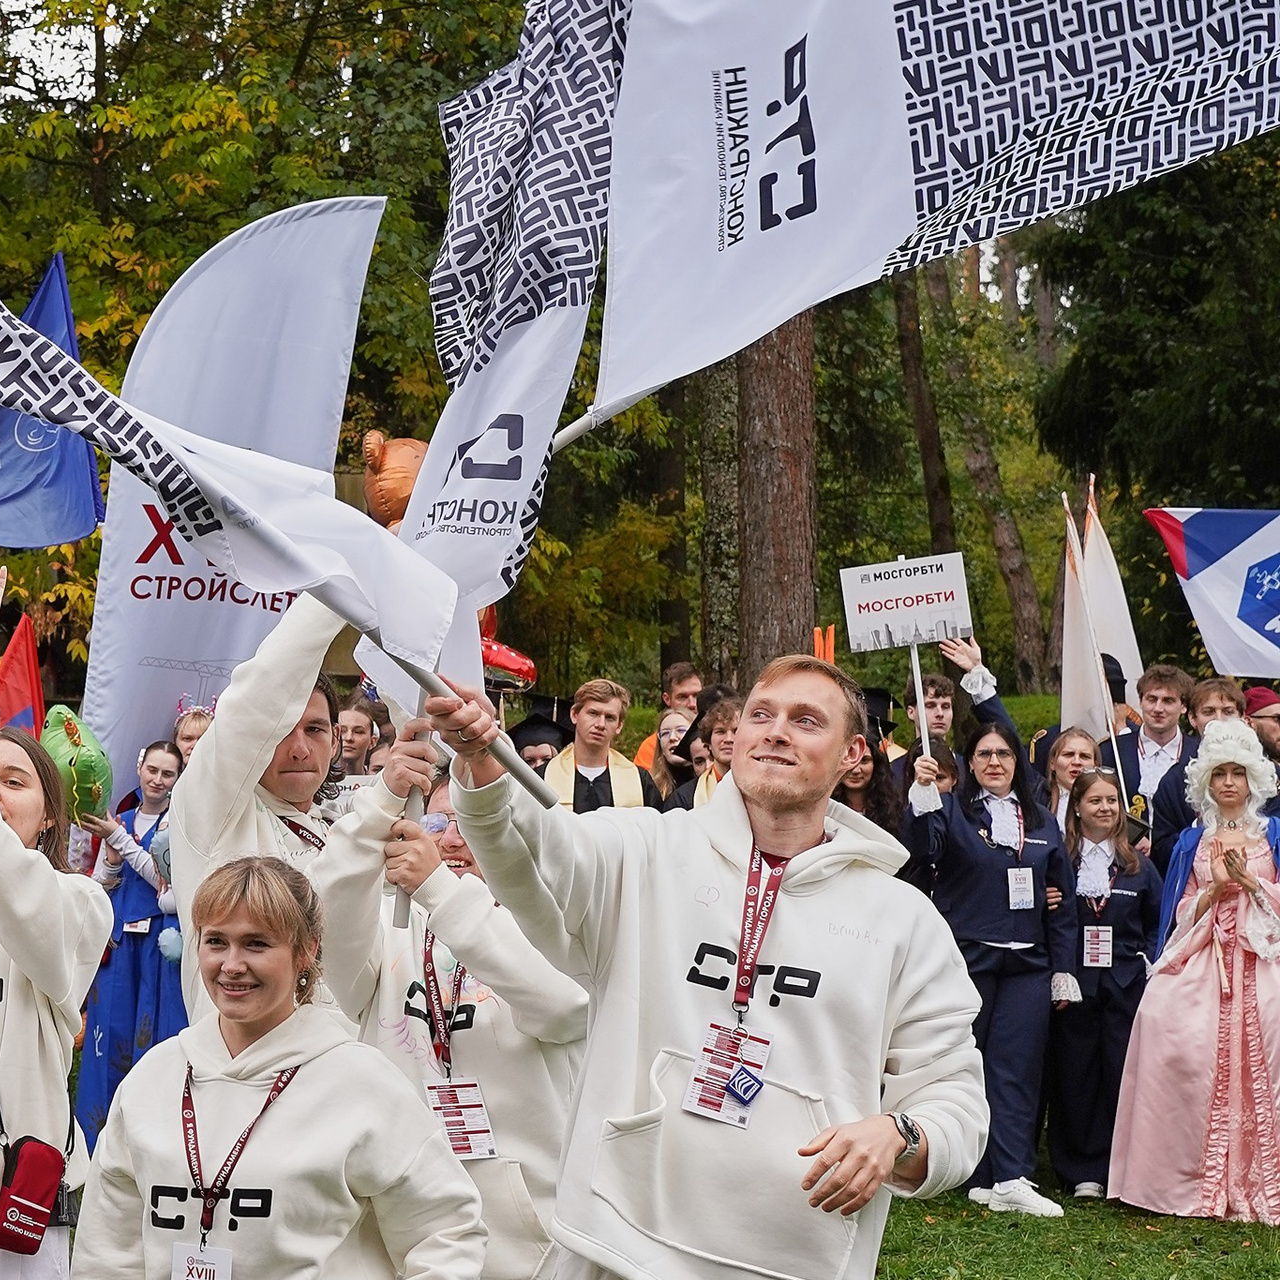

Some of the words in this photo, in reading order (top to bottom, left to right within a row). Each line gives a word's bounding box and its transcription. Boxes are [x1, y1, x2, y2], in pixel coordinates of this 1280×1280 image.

[873, 563, 944, 582] МОСГОРБТИ
[857, 590, 955, 614] МОСГОРБТИ
[746, 921, 765, 964] ФУНДАМЕНТ
[760, 889, 775, 921] ГОРОДА
[187, 1129, 199, 1176] ФУНДАМЕНТ
[216, 1141, 242, 1187] ФУНДАМЕНТ
[186, 1265, 216, 1280] XVIII
